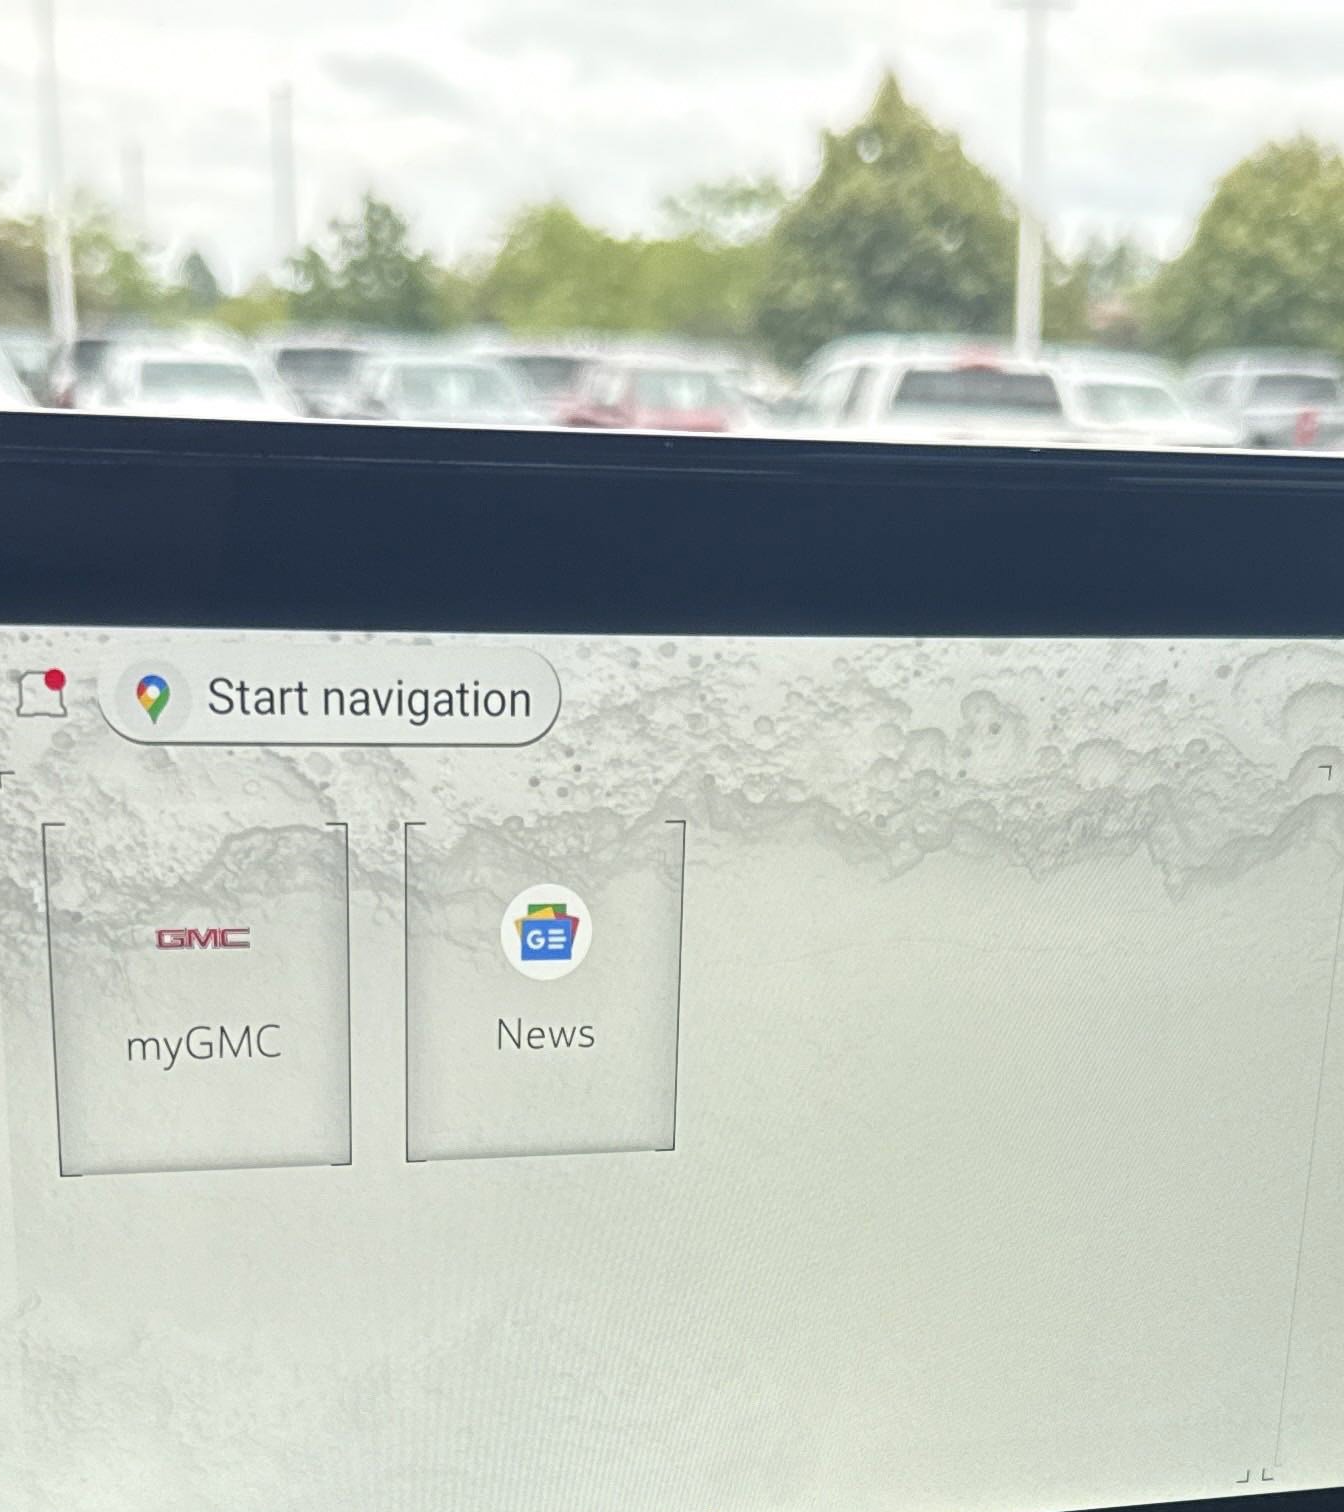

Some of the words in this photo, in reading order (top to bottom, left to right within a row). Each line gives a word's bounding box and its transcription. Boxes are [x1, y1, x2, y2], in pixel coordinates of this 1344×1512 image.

[208, 676, 309, 717] Start
[323, 678, 531, 727] navigation
[156, 927, 251, 949] GMC
[127, 1024, 281, 1071] myGMC
[497, 1017, 595, 1050] News
